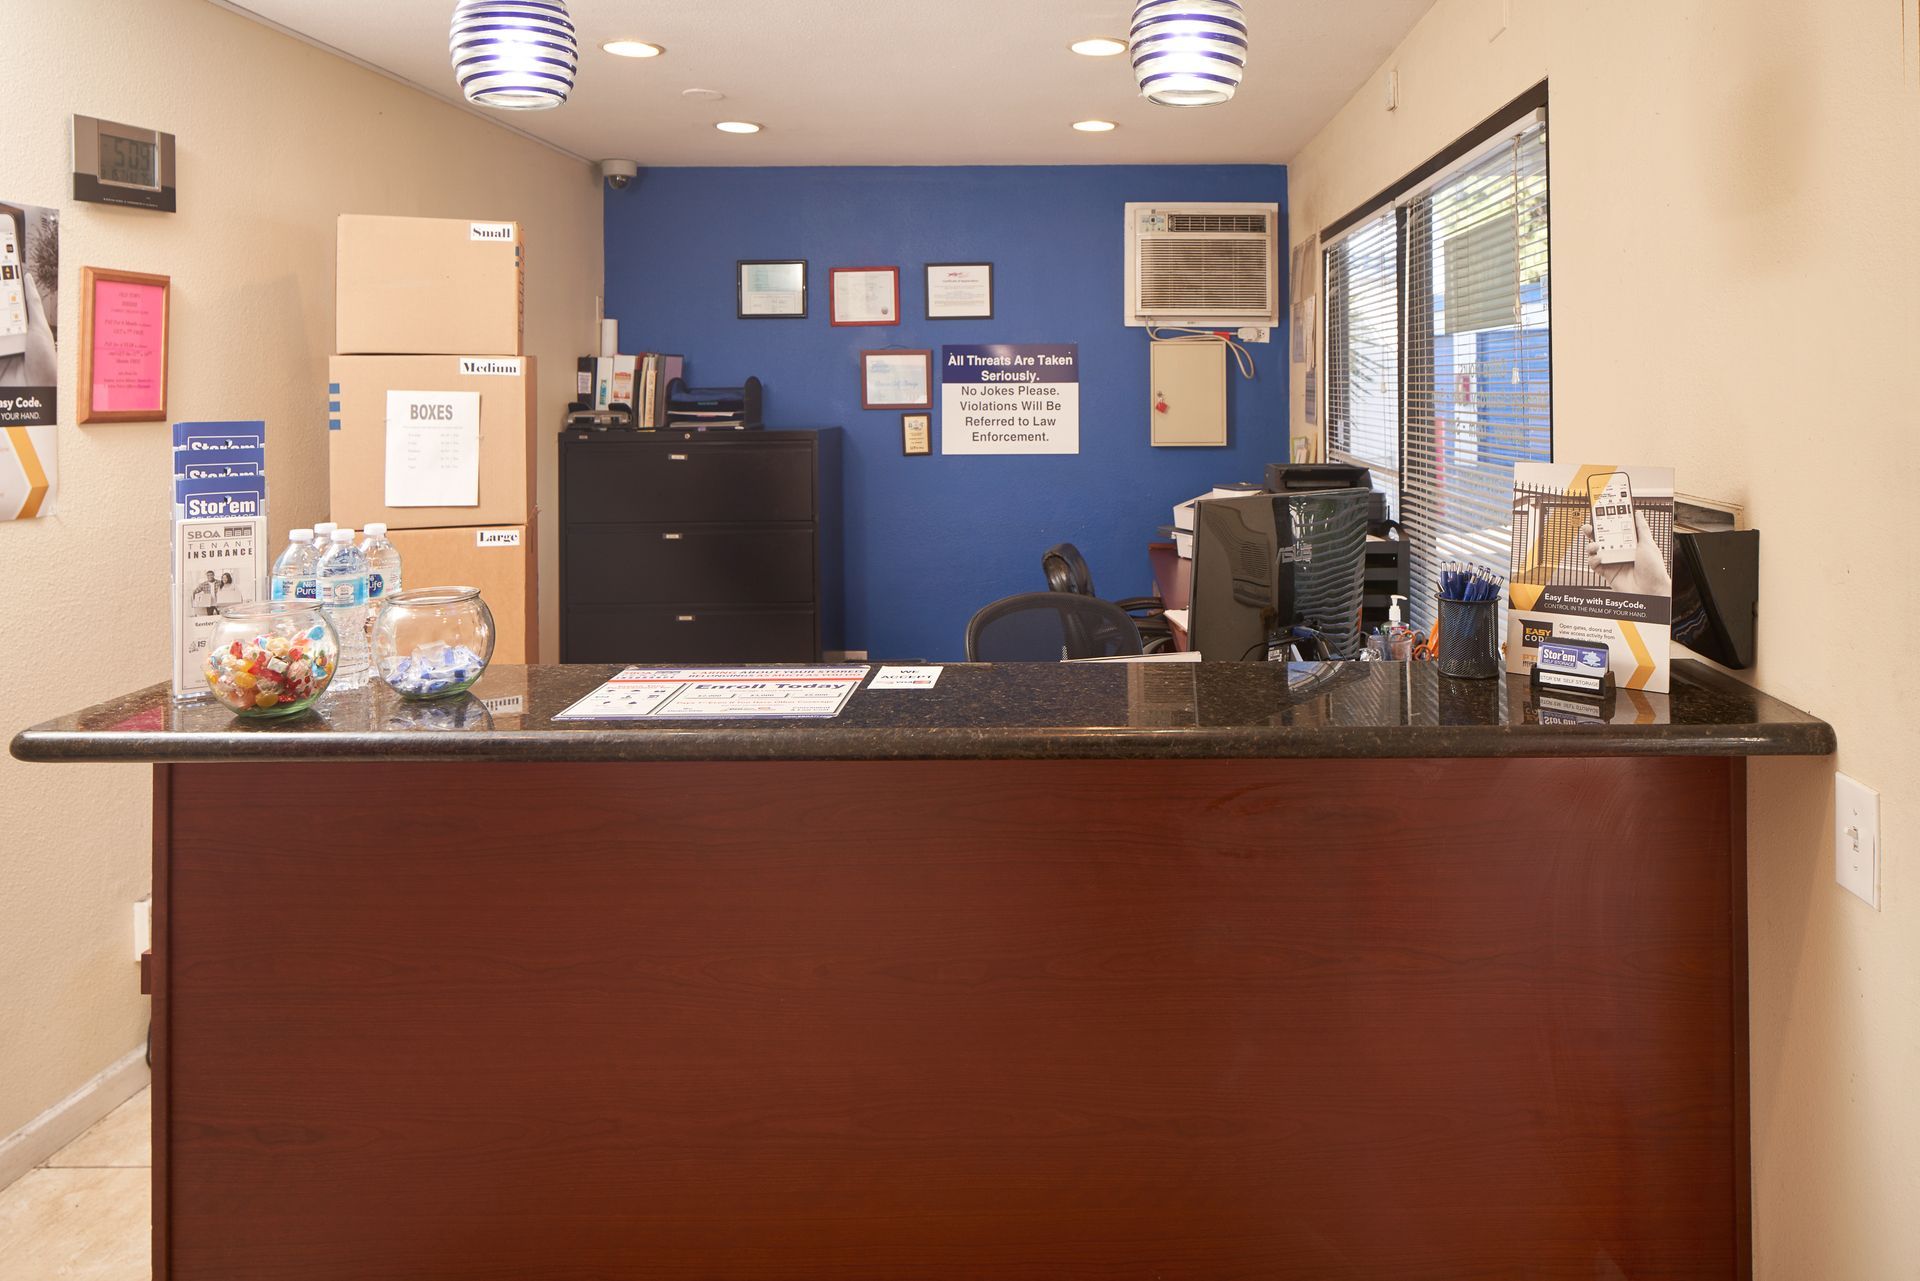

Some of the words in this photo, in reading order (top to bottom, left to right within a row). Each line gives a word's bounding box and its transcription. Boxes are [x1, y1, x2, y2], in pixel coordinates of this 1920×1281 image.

[472, 227, 510, 238] Small
[948, 355, 964, 366] All
[967, 355, 1012, 366] Threats
[1014, 355, 1035, 366] Are
[1037, 354, 1073, 366] Taken
[464, 363, 516, 373] Medium
[981, 370, 1040, 383] Seriously.
[961, 386, 977, 396] No
[980, 386, 1015, 396] Jokes
[1018, 386, 1060, 396] Please.
[15, 397, 42, 408] Code.
[960, 401, 1018, 411] Violations
[1021, 401, 1043, 411] Will
[1046, 401, 1062, 411] Be
[1, 412, 20, 420] YOUR
[21, 412, 40, 420] HAND.
[410, 404, 453, 420] BOXES
[965, 416, 1015, 426] Referred
[1018, 417, 1030, 426] to
[1033, 416, 1056, 426] Law
[972, 432, 1049, 442] Enforcement.
[189, 496, 255, 515] Stor'em
[187, 530, 221, 539] SBOA
[480, 532, 517, 542] Large
[187, 540, 252, 550] TENANT
[187, 548, 253, 559] INSURANCE
[296, 587, 316, 595] Pure
[1545, 593, 1562, 602] Easy
[1564, 594, 1584, 605] Entry
[1586, 597, 1603, 605] with
[1606, 599, 1646, 610] EasyCode.
[1629, 610, 1647, 618] HAND.
[1525, 628, 1551, 638] EASY
[1544, 648, 1575, 662] Stor'em
